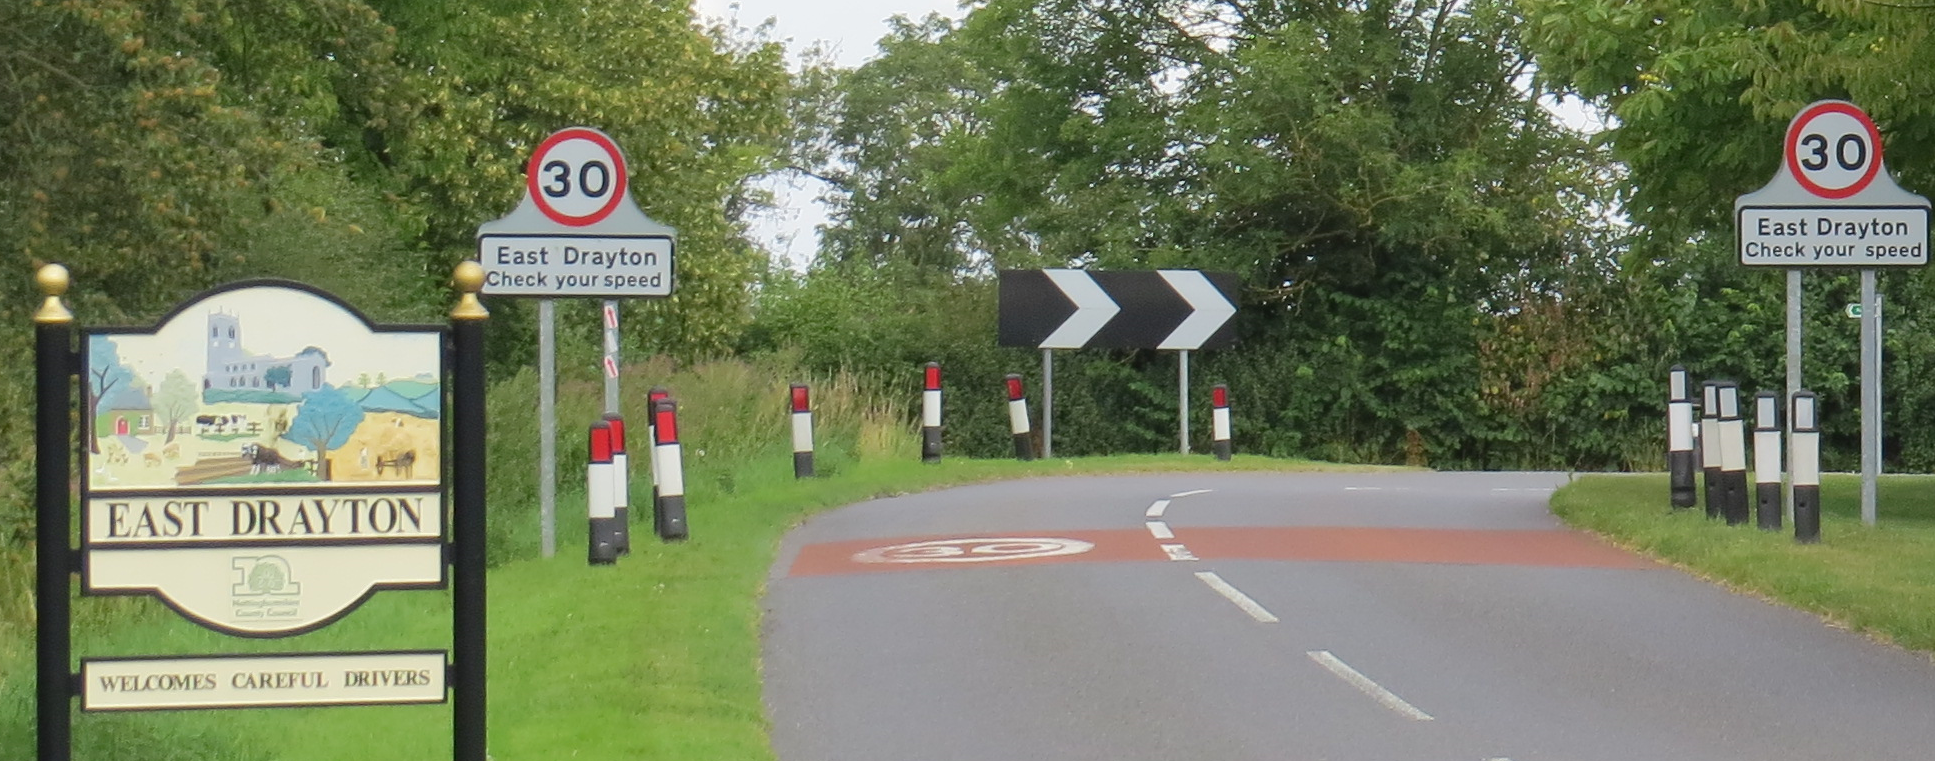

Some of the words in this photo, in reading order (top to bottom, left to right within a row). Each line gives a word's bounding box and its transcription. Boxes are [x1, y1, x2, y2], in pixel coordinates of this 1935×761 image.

[1801, 134, 1867, 171] 30
[543, 160, 610, 198] 30
[1758, 218, 1808, 236] East
[1817, 218, 1909, 239] Drayton
[497, 246, 549, 265] East
[564, 246, 657, 269] Drayton
[1745, 242, 1806, 258] Check
[1813, 245, 1855, 261] your
[1866, 243, 1922, 260] speed
[487, 271, 547, 288] Check
[555, 274, 599, 290] your
[604, 272, 662, 289] speed
[107, 500, 209, 538] EAST
[230, 497, 424, 536] DRAYTON
[99, 673, 217, 692] WELCOMES
[231, 671, 330, 690] CAREFUL
[344, 669, 431, 688] DRIVERS
